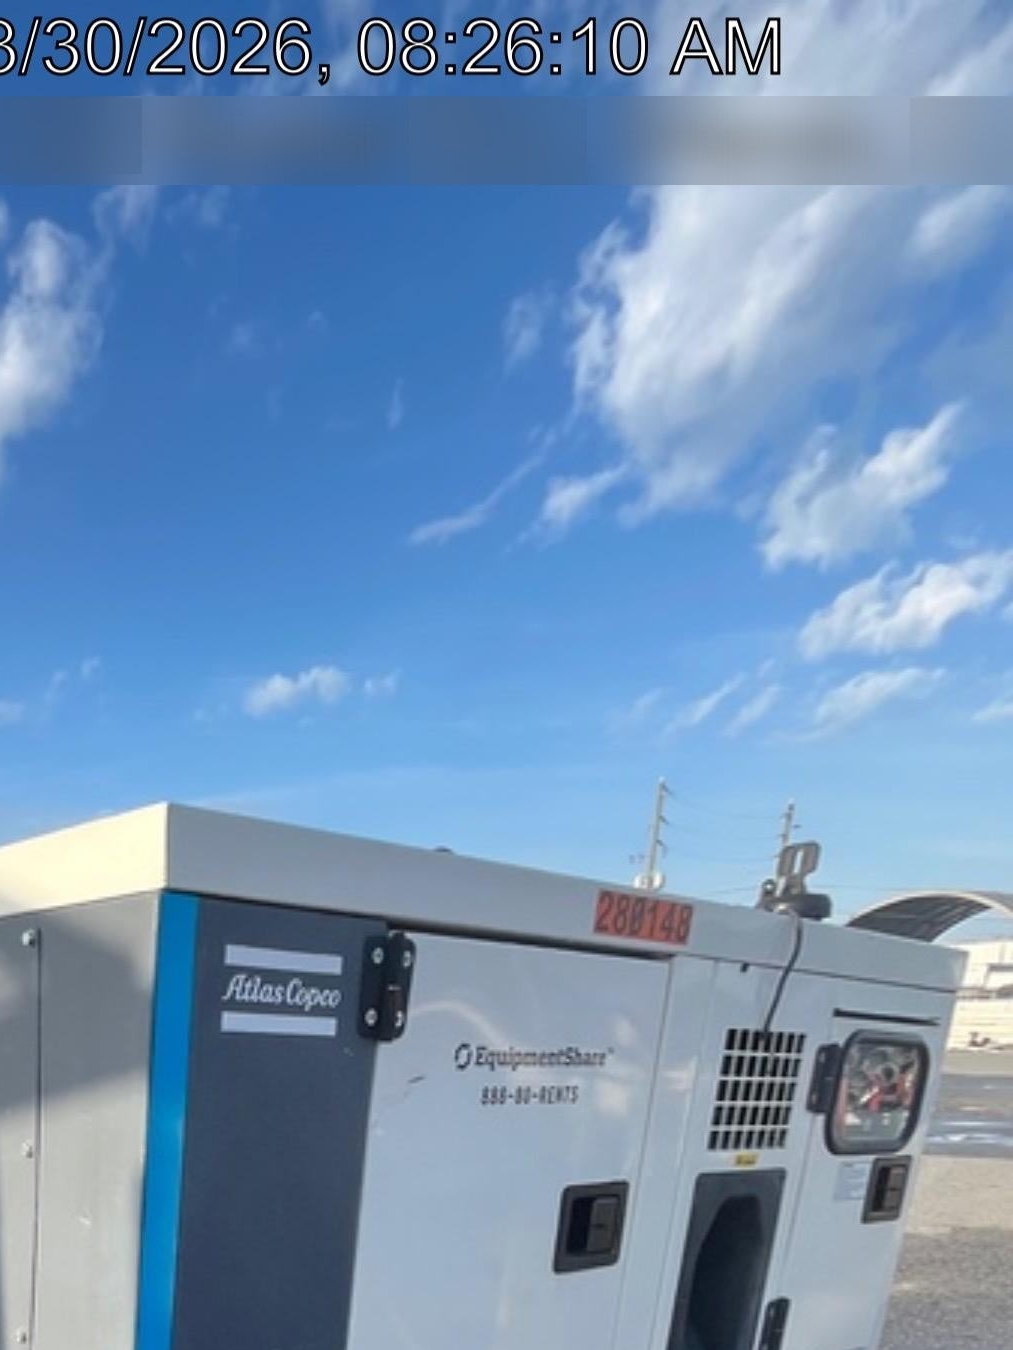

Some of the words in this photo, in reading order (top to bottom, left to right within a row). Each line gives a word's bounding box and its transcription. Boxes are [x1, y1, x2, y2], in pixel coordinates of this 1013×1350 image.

[593, 888, 693, 944] 280148
[221, 974, 285, 1003] Atlas
[286, 977, 341, 1012] Copco
